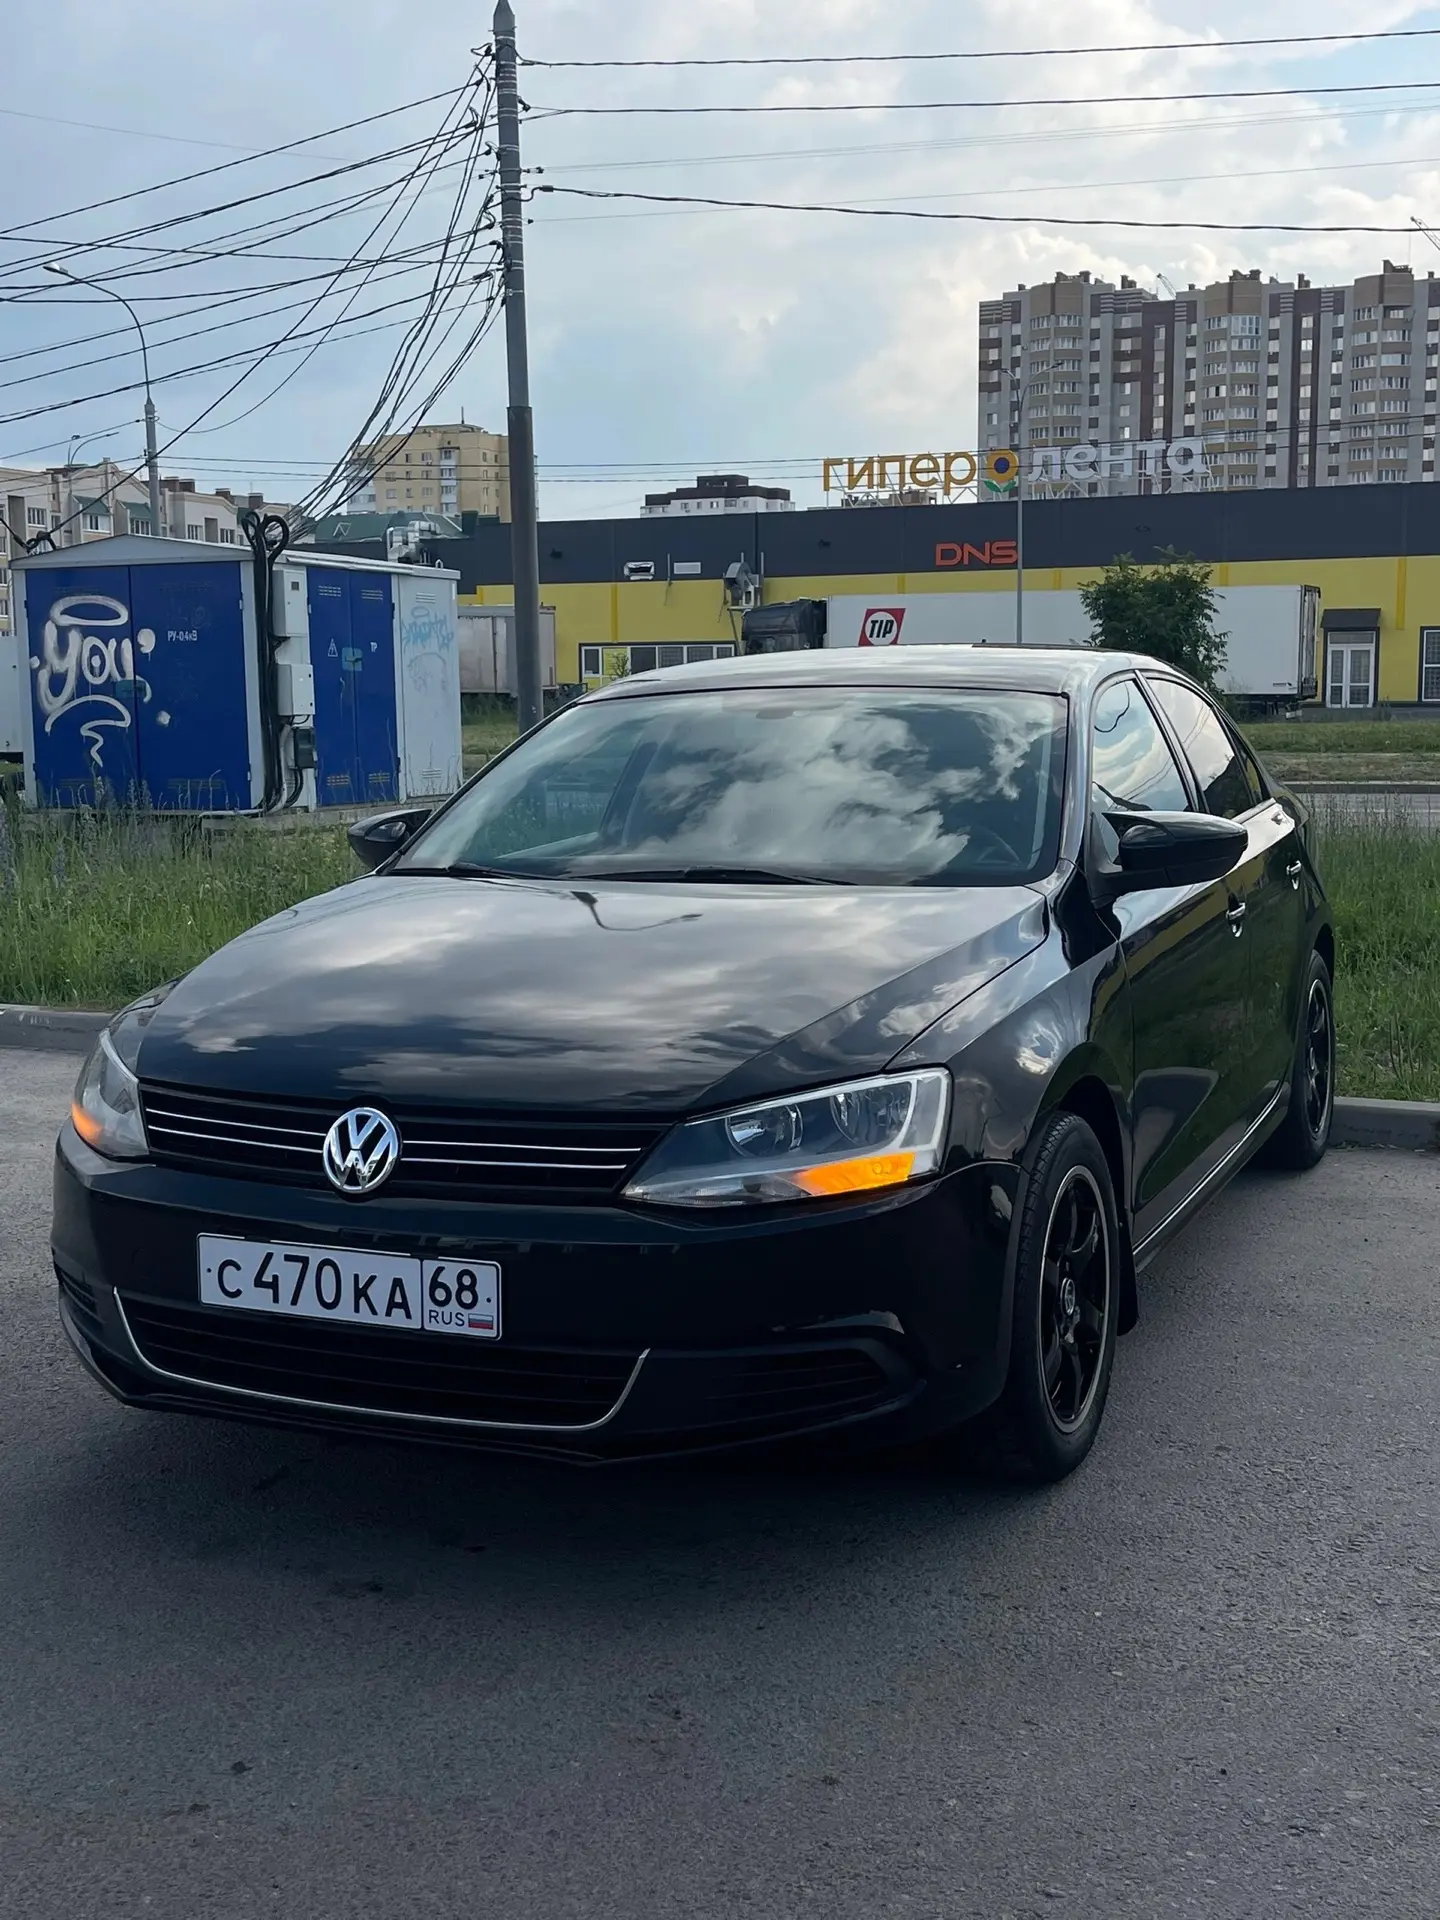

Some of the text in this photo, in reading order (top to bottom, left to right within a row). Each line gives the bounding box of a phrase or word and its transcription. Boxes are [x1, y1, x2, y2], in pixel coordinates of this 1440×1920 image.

[823, 438, 1211, 496] гипер лента
[935, 541, 1017, 566] DNS
[869, 619, 895, 638] TIP
[429, 1266, 479, 1309] 68
[429, 1310, 465, 1327] RUS
